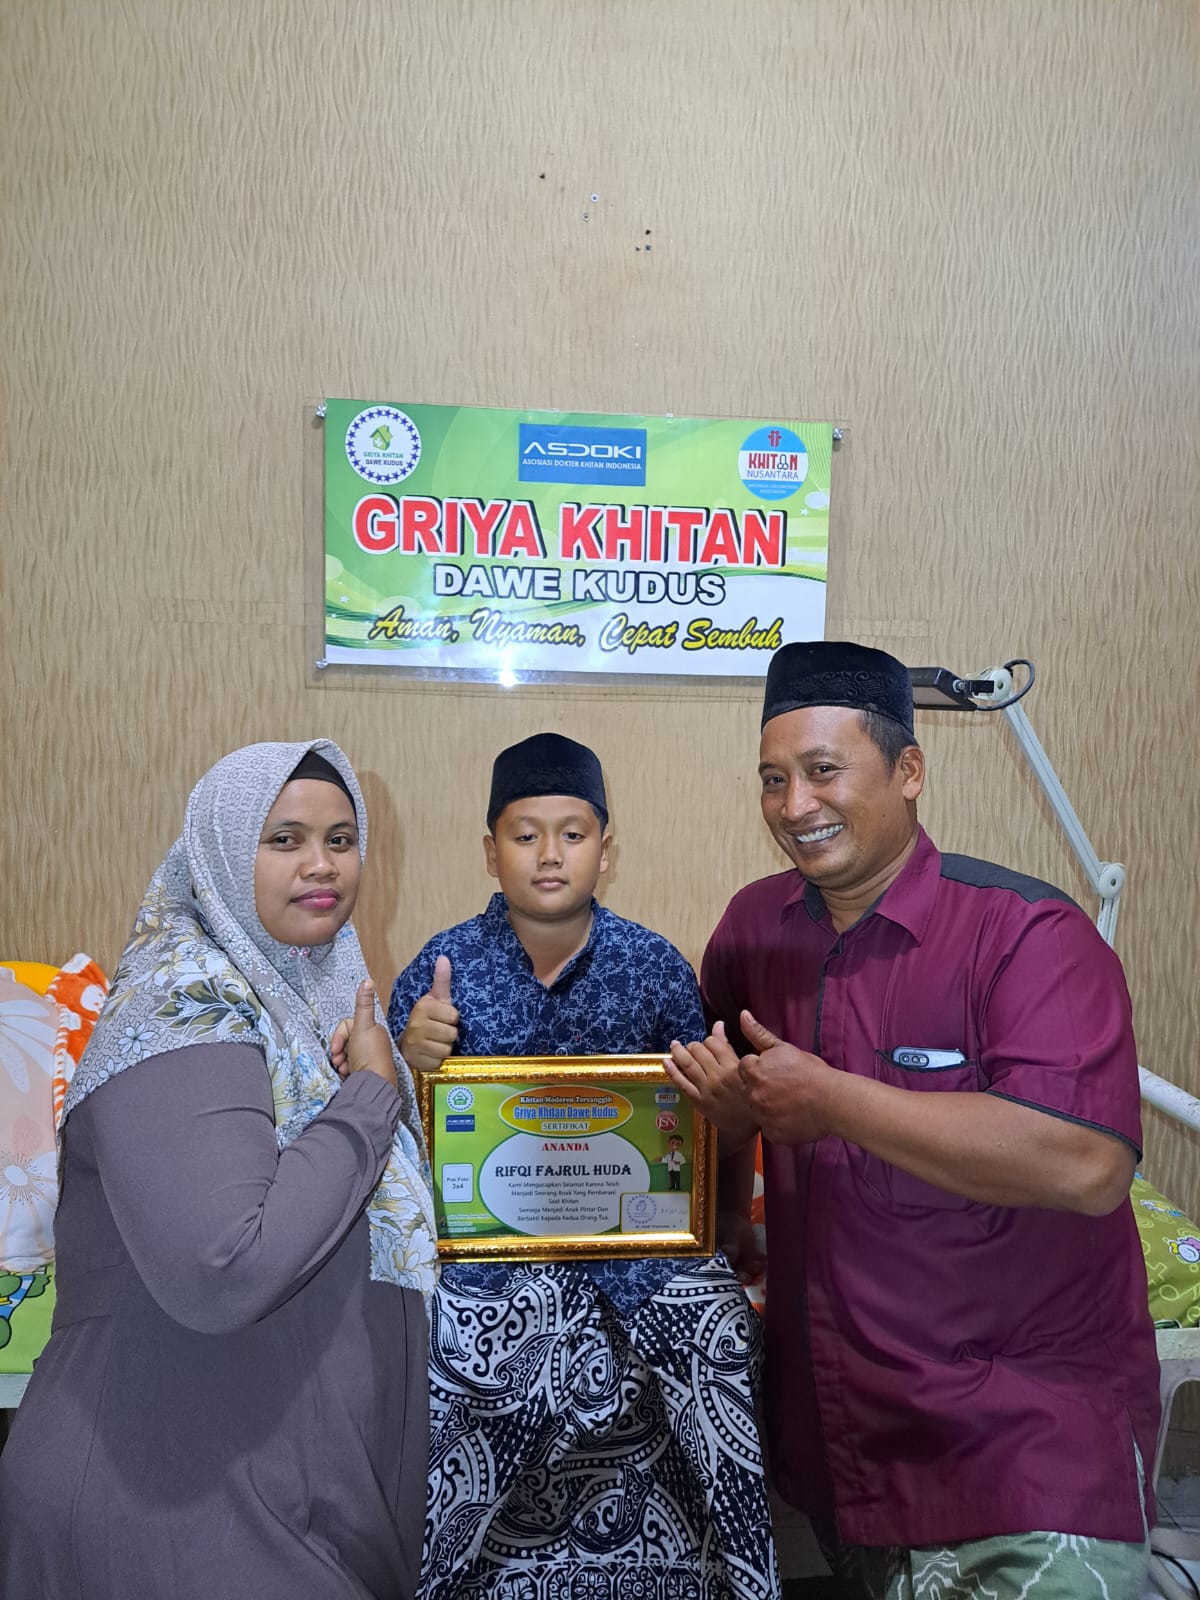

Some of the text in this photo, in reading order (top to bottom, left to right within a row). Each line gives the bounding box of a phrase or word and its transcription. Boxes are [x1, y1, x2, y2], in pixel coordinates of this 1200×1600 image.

[523, 441, 641, 459] ASDOKI
[522, 458, 641, 470] ASOSIASI DOKTER KHITAN INDONESIA
[747, 470, 799, 480] NUSANTARA
[352, 493, 787, 567] GRIYA KHITAN
[433, 563, 726, 606] DAWE KUDUS
[368, 604, 784, 654] Aman, Nyaman, Cepat Sembuh
[520, 1096, 544, 1104] Khitan
[513, 1106, 618, 1120] Griya Khitan Dawe Kudus
[542, 1122, 589, 1130] SERTIFIKAT
[541, 1143, 590, 1152] ANANDA
[495, 1164, 632, 1177] RIFQI FAJRUL HUDA
